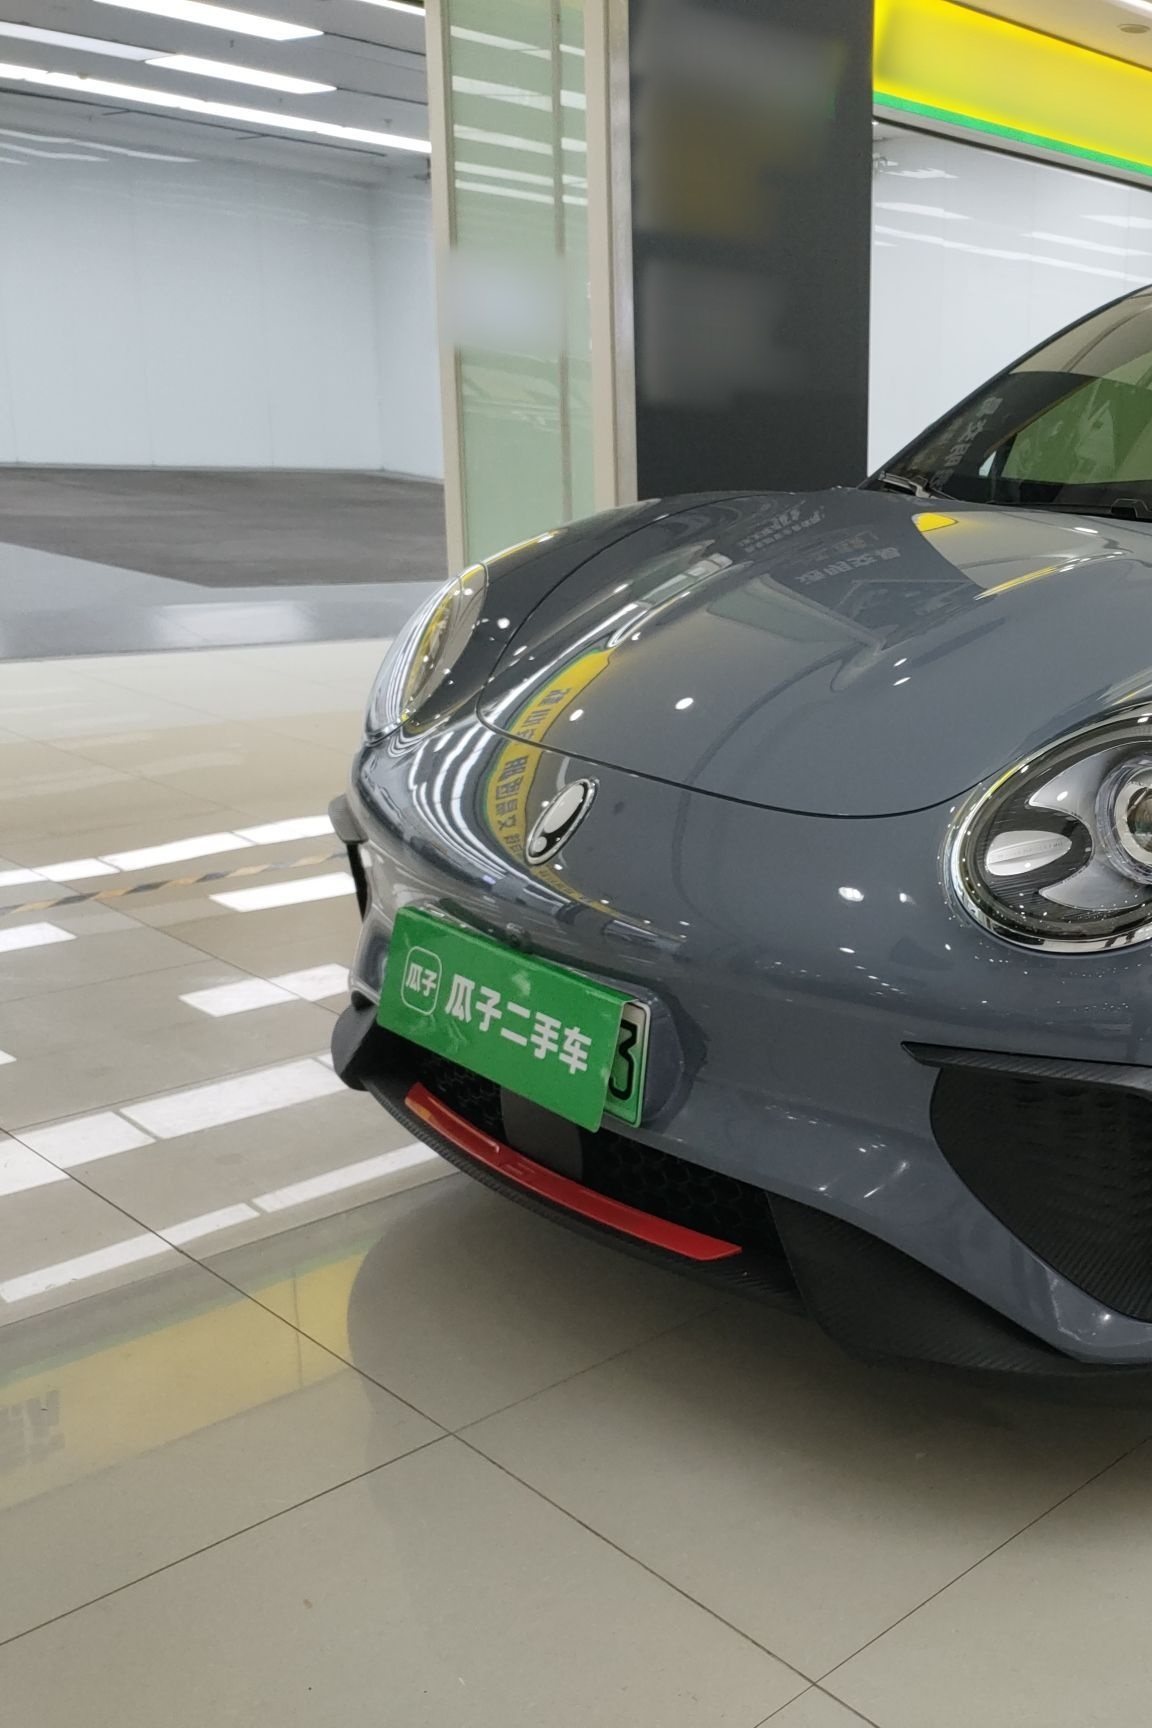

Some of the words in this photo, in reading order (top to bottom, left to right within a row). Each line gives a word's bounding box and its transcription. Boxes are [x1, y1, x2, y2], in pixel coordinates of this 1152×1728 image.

[405, 962, 437, 997] 瓜子
[445, 974, 592, 1075] 瓜子二手车
